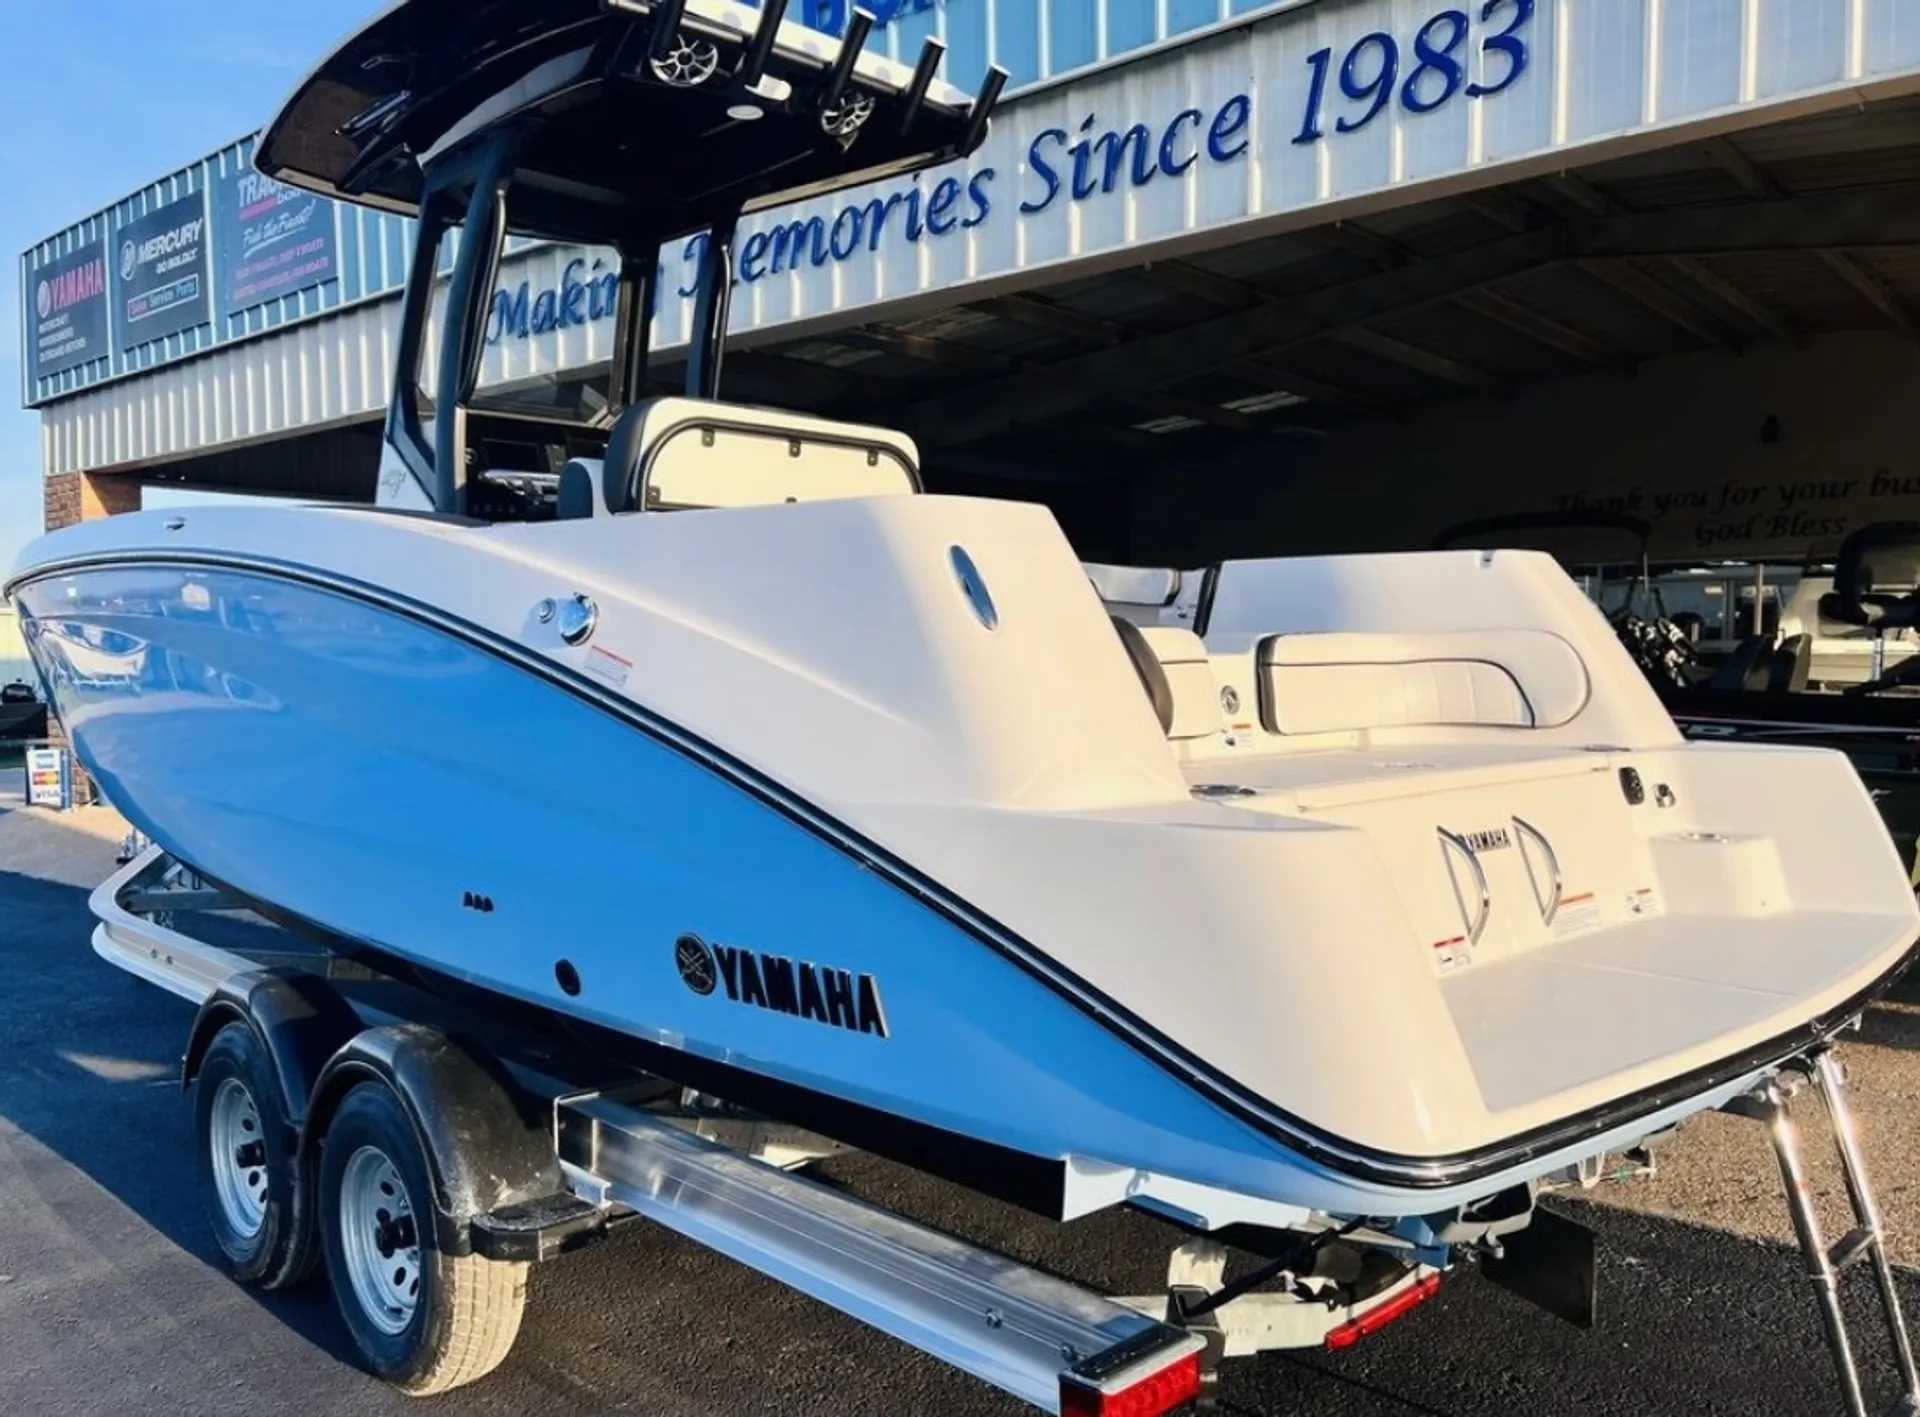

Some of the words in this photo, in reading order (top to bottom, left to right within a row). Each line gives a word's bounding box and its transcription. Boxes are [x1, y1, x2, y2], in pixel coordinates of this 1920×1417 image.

[487, 258, 664, 345] Maki
[1020, 93, 1250, 214] Since
[1291, 0, 1536, 145] 1983
[137, 217, 203, 265] MERCURY
[51, 257, 104, 312] YAMAHA
[1652, 490, 1708, 518] you
[1709, 479, 1767, 515] for
[1777, 476, 1859, 512] your
[1695, 511, 1763, 548] God
[1765, 509, 1850, 540] Bless
[1466, 828, 1511, 851] YAMAHA
[712, 942, 890, 1041] YAMAHA
